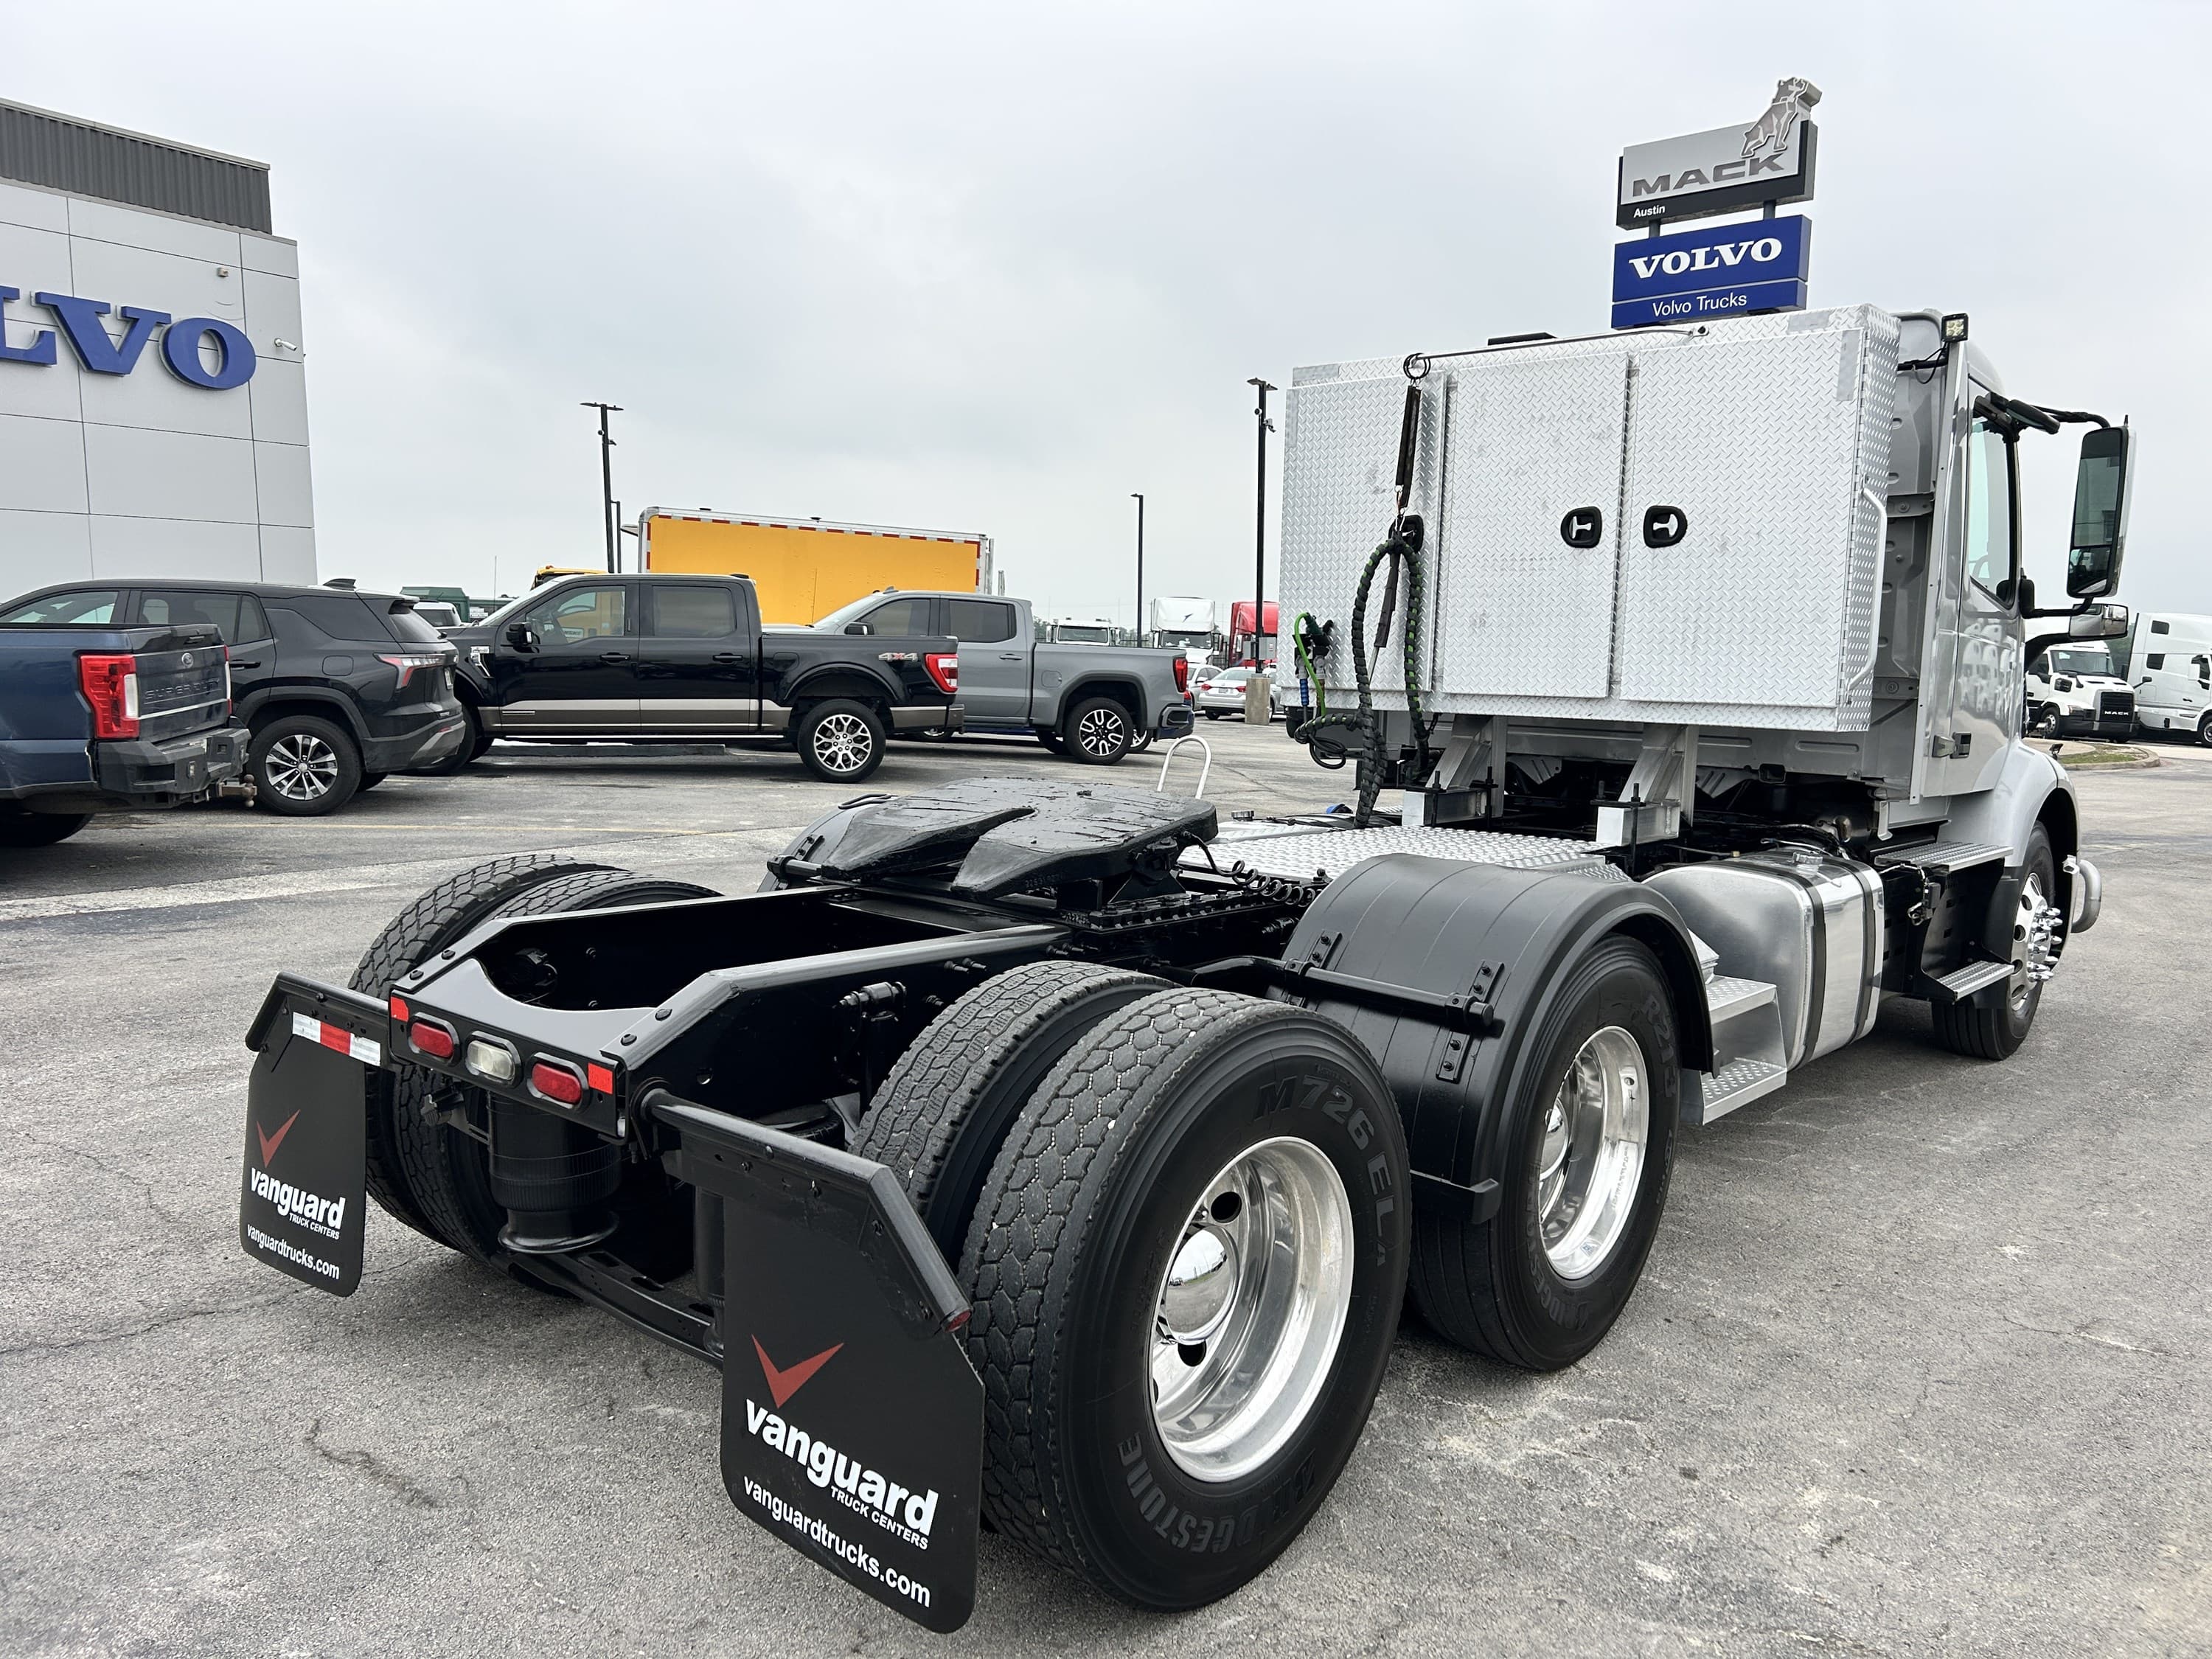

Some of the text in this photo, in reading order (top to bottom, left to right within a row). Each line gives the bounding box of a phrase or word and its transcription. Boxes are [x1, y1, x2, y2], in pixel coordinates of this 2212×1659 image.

[1632, 152, 1785, 198] MACK
[1633, 204, 1666, 218] Austin
[1628, 237, 1783, 279] VOLVO
[1652, 293, 1747, 317] Volvo Trucks
[144, 684, 192, 700] SUPER
[1252, 1074, 1375, 1152] M726
[251, 1167, 346, 1230] vanguard
[289, 1212, 340, 1240] TRUCK CENTERS
[247, 1224, 340, 1280] vanguardtrucks.com
[746, 1399, 939, 1537] vanguard
[744, 1475, 931, 1607] vanguardtrucks.com
[830, 1486, 928, 1550] TRUCK CENTERS
